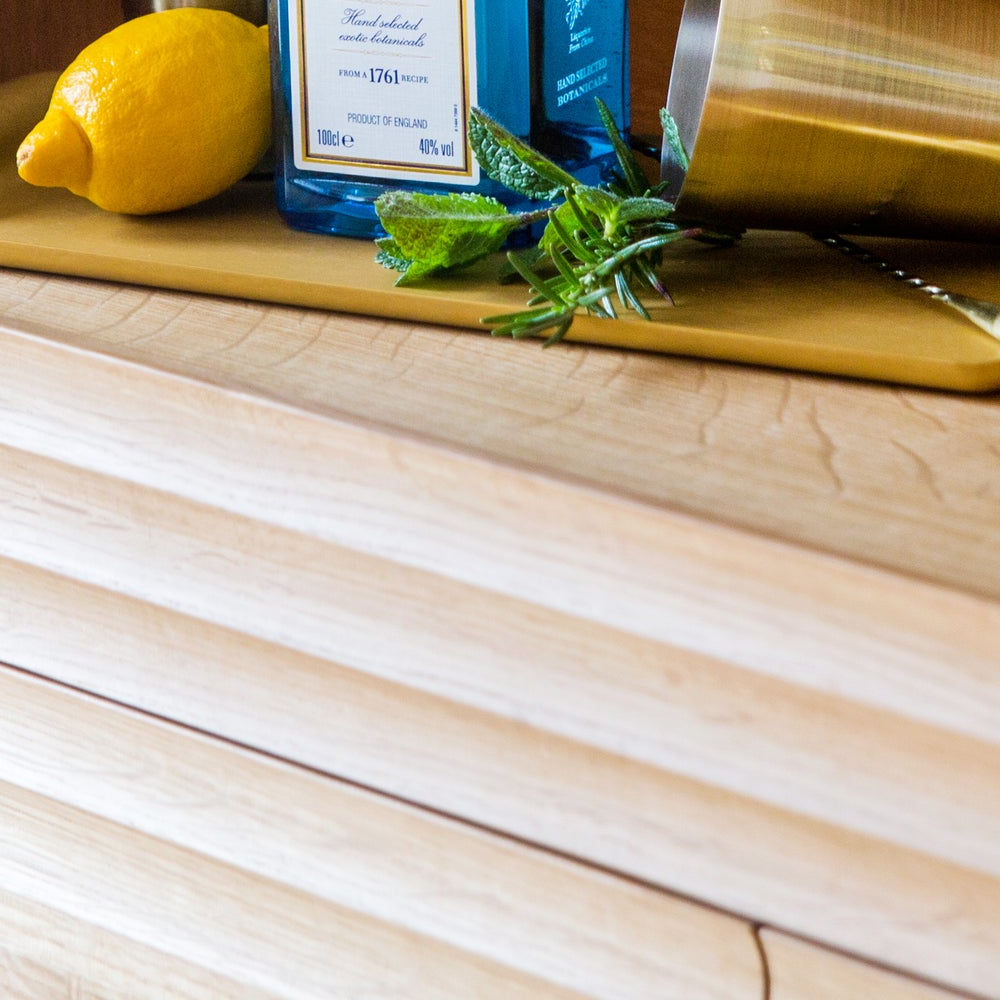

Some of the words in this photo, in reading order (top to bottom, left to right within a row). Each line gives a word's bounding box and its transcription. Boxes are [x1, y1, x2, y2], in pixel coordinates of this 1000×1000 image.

[341, 8, 382, 28] Hand
[379, 14, 424, 31] selected
[338, 32, 368, 43] exotic
[370, 30, 428, 48] botanicals
[338, 68, 362, 78] FROM
[362, 71, 368, 79] A
[369, 67, 400, 85] 1761
[401, 74, 429, 84] RECIPE
[557, 73, 576, 91] HAND
[557, 73, 608, 108] BOTANICALS
[347, 112, 381, 126] PRODUCT
[382, 115, 391, 126] OF
[394, 117, 428, 129] ENGLAND
[317, 128, 340, 147] 100cl
[419, 138, 439, 156] 40%
[441, 141, 454, 157] vol
